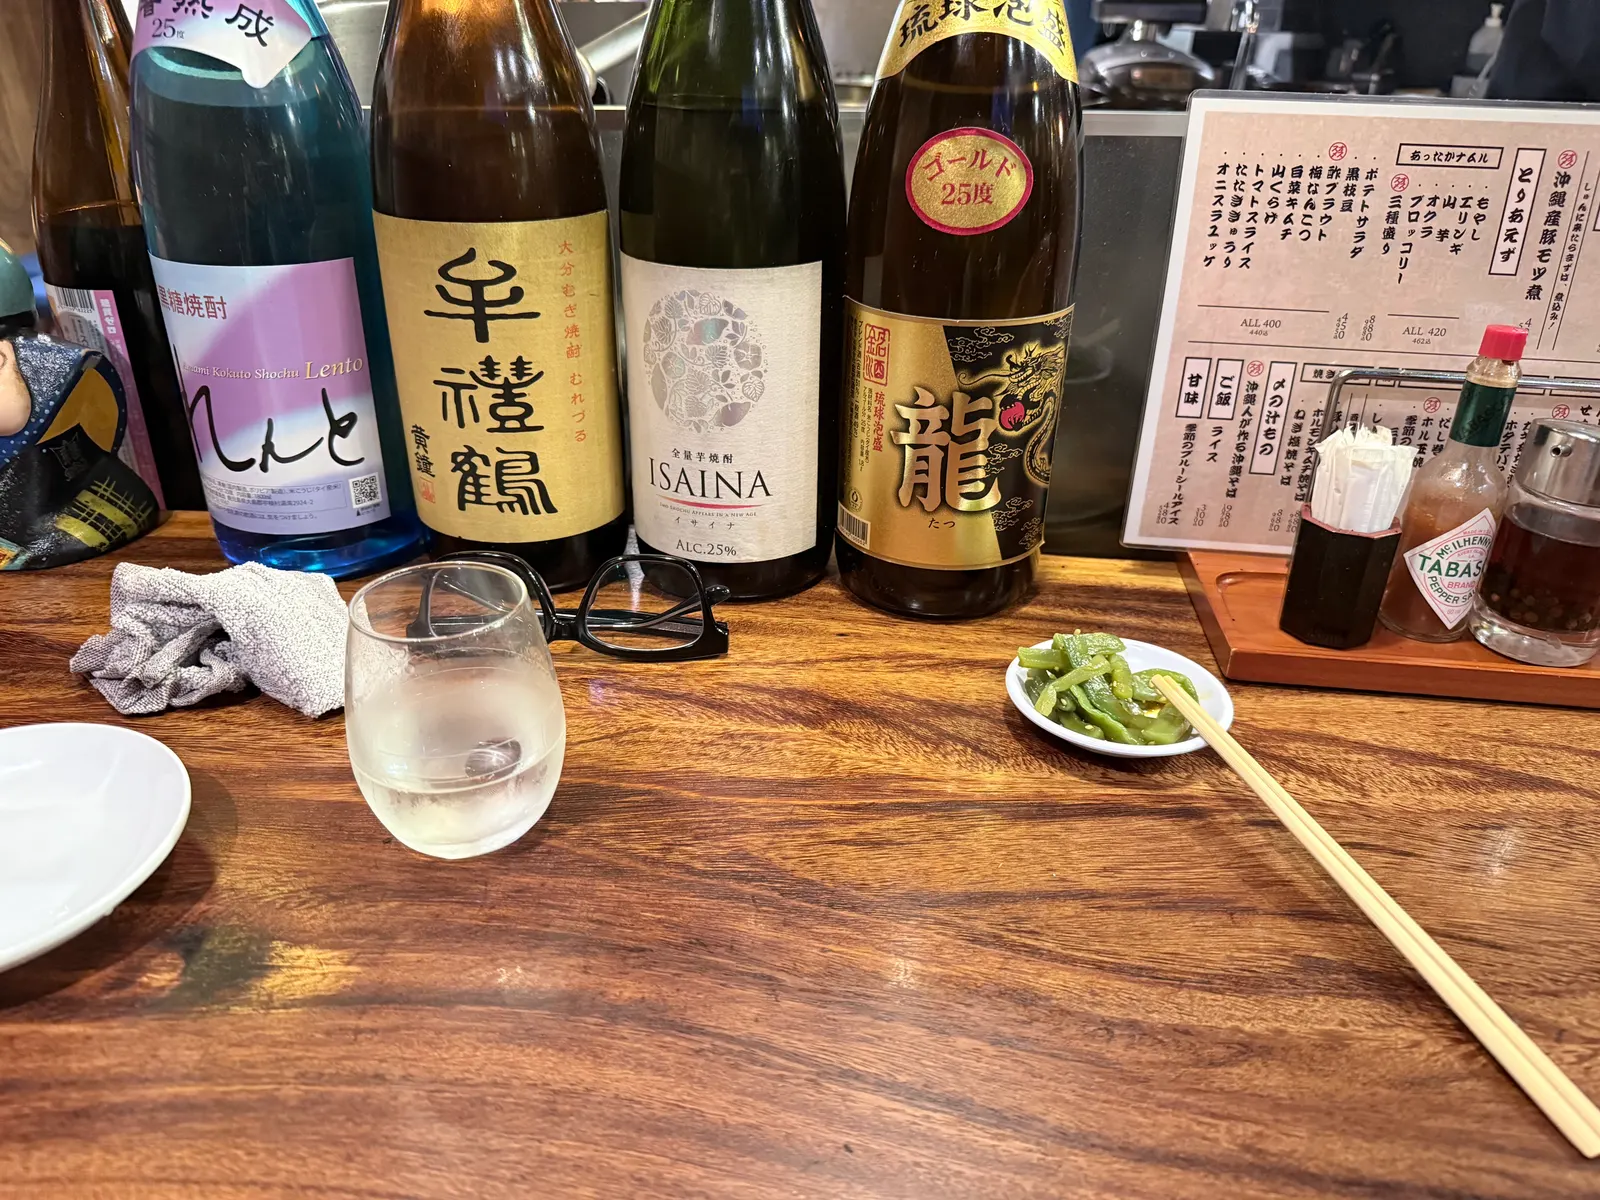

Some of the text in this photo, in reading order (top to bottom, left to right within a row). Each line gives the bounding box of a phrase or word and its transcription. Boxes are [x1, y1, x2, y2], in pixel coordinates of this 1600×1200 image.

[152, 18, 185, 40] 25度
[923, 148, 1016, 182] ゴールド
[1410, 150, 1489, 164] あったかナムル
[941, 182, 994, 206] 25度
[1264, 165, 1285, 224] 山くらげ
[1280, 165, 1303, 240] 白菜キムチ
[1299, 165, 1323, 241] 梅なんこつ
[1339, 167, 1360, 212] 黒枝豆
[1203, 163, 1230, 267] オニスラユッケ
[1222, 163, 1248, 269] たたききゅうり
[1238, 164, 1264, 269] トマトスライス
[1350, 168, 1378, 259] ポテトサラダ
[1381, 195, 1402, 255] 三種盛り
[1420, 195, 1440, 239] オクラ
[1436, 195, 1456, 242] 山芋
[1450, 196, 1473, 255] エリンギ
[1471, 197, 1490, 241] もやし
[1398, 195, 1424, 284] ブロッコリー
[1525, 171, 1571, 301] 沖縄産豚モツ煮
[558, 240, 587, 442] 大分むぎ焼酎 むれづる
[1240, 318, 1281, 328] ALL 400
[1402, 326, 1447, 337] ALL 420
[212, 366, 251, 379] Kokuto
[254, 367, 299, 379] Shochu
[305, 357, 363, 380] Lento
[1184, 374, 1202, 405] 甘味
[1215, 375, 1235, 406] ご飯
[1259, 379, 1285, 455] 〆の汁もの
[672, 448, 733, 463] 全量芋焼酎
[890, 387, 1001, 512] 龍
[1206, 426, 1223, 462] ライス
[649, 457, 773, 499] ISAINA
[1168, 424, 1197, 525] 季節のブルーシールアイス
[675, 516, 735, 530] イサイナ
[928, 519, 956, 529] たつ
[676, 539, 737, 556] ALC.25%
[1418, 554, 1484, 578] TABAS
[1428, 576, 1459, 604] PEPPER
